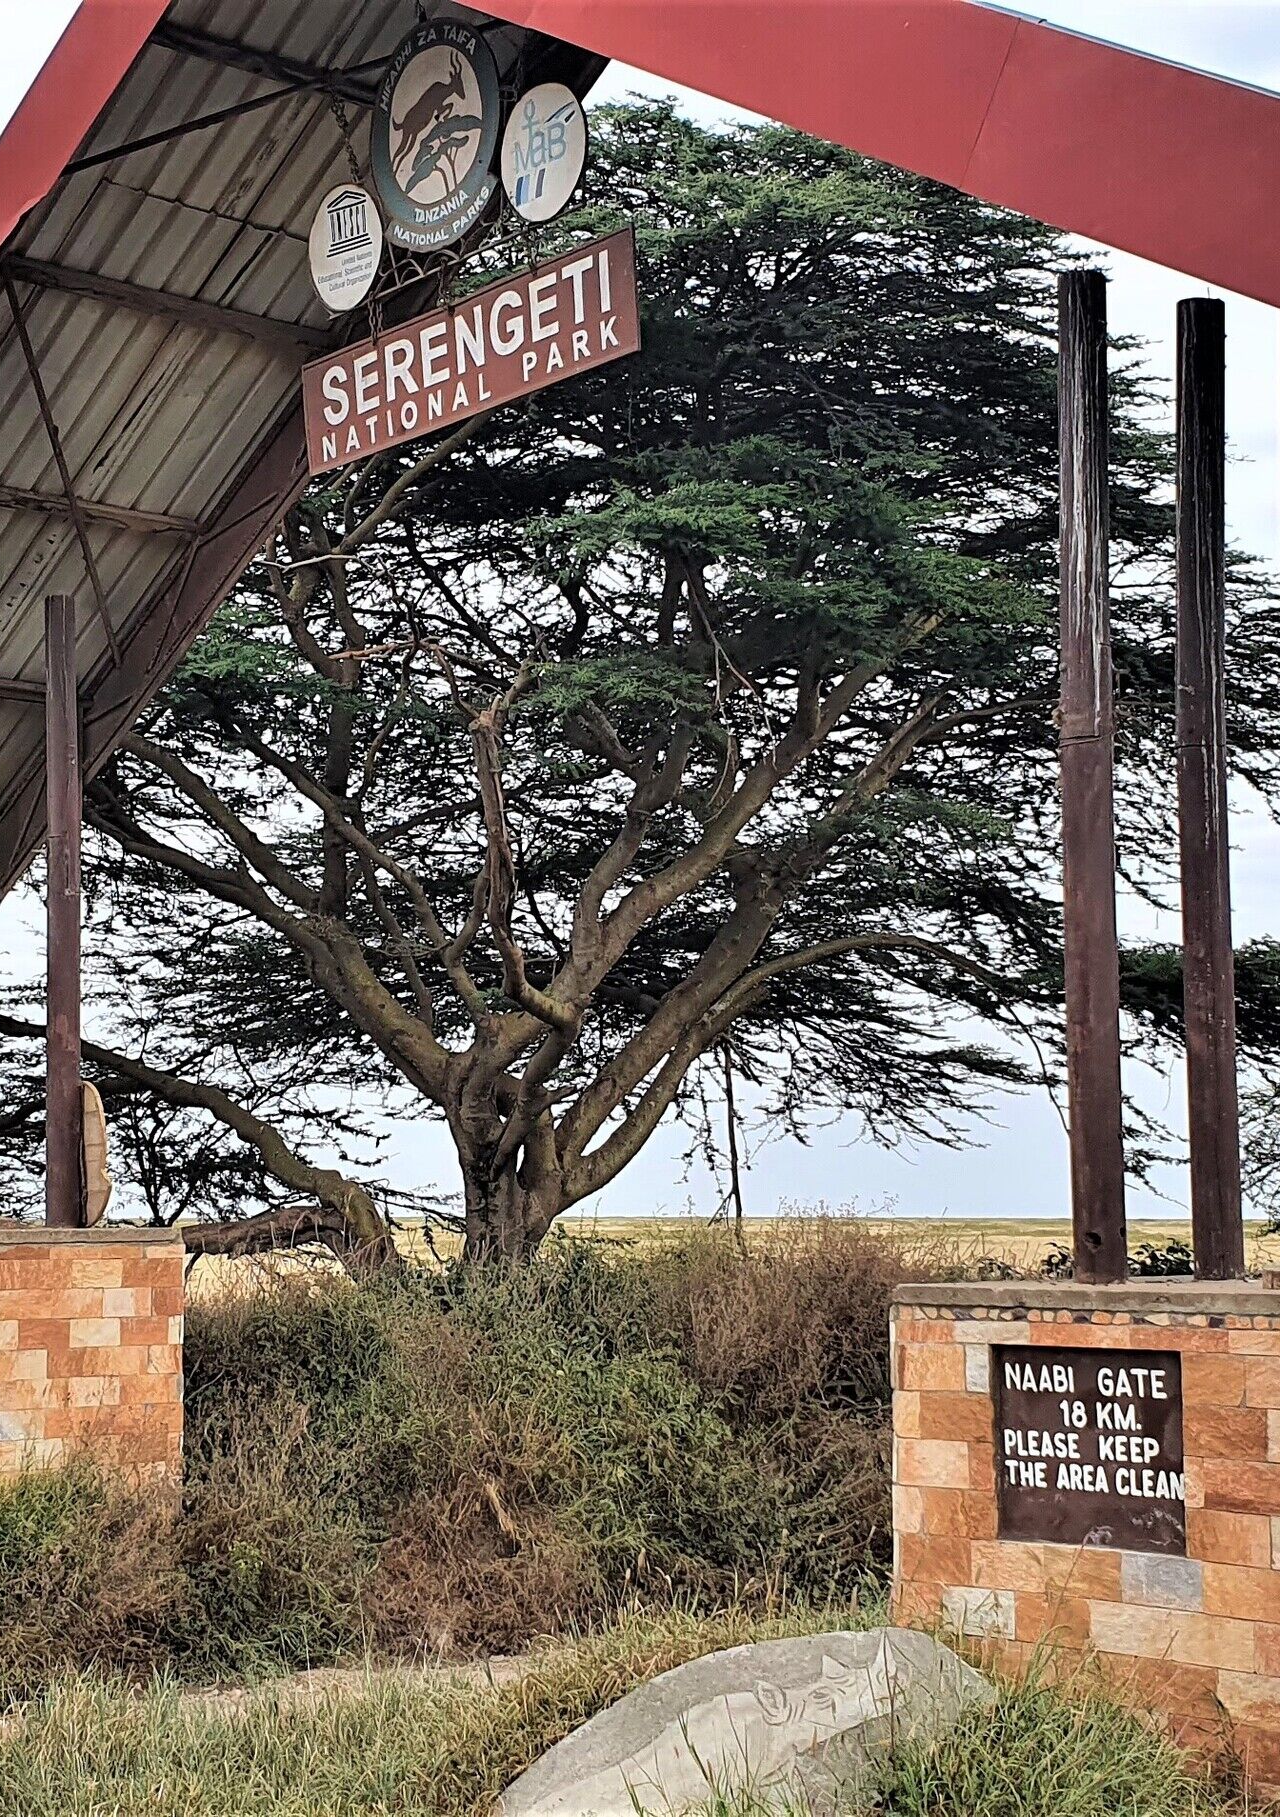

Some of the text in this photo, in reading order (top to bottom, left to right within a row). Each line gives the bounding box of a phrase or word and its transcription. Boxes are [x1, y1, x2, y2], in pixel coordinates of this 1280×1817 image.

[417, 28, 437, 46] ZA
[443, 25, 476, 55] TAIFA
[394, 186, 489, 245] NATIONAL PARKS
[414, 189, 469, 223] TANZANIA
[322, 250, 611, 426] SERENGETI
[322, 316, 619, 462] NATIONAL PARK
[1004, 1362, 1168, 1399] NAABI GATE
[1059, 1400, 1142, 1431] 18 KM.
[1003, 1428, 1160, 1463] PLEASE KEEP
[1004, 1459, 1185, 1500] THE AREA CLEAN
